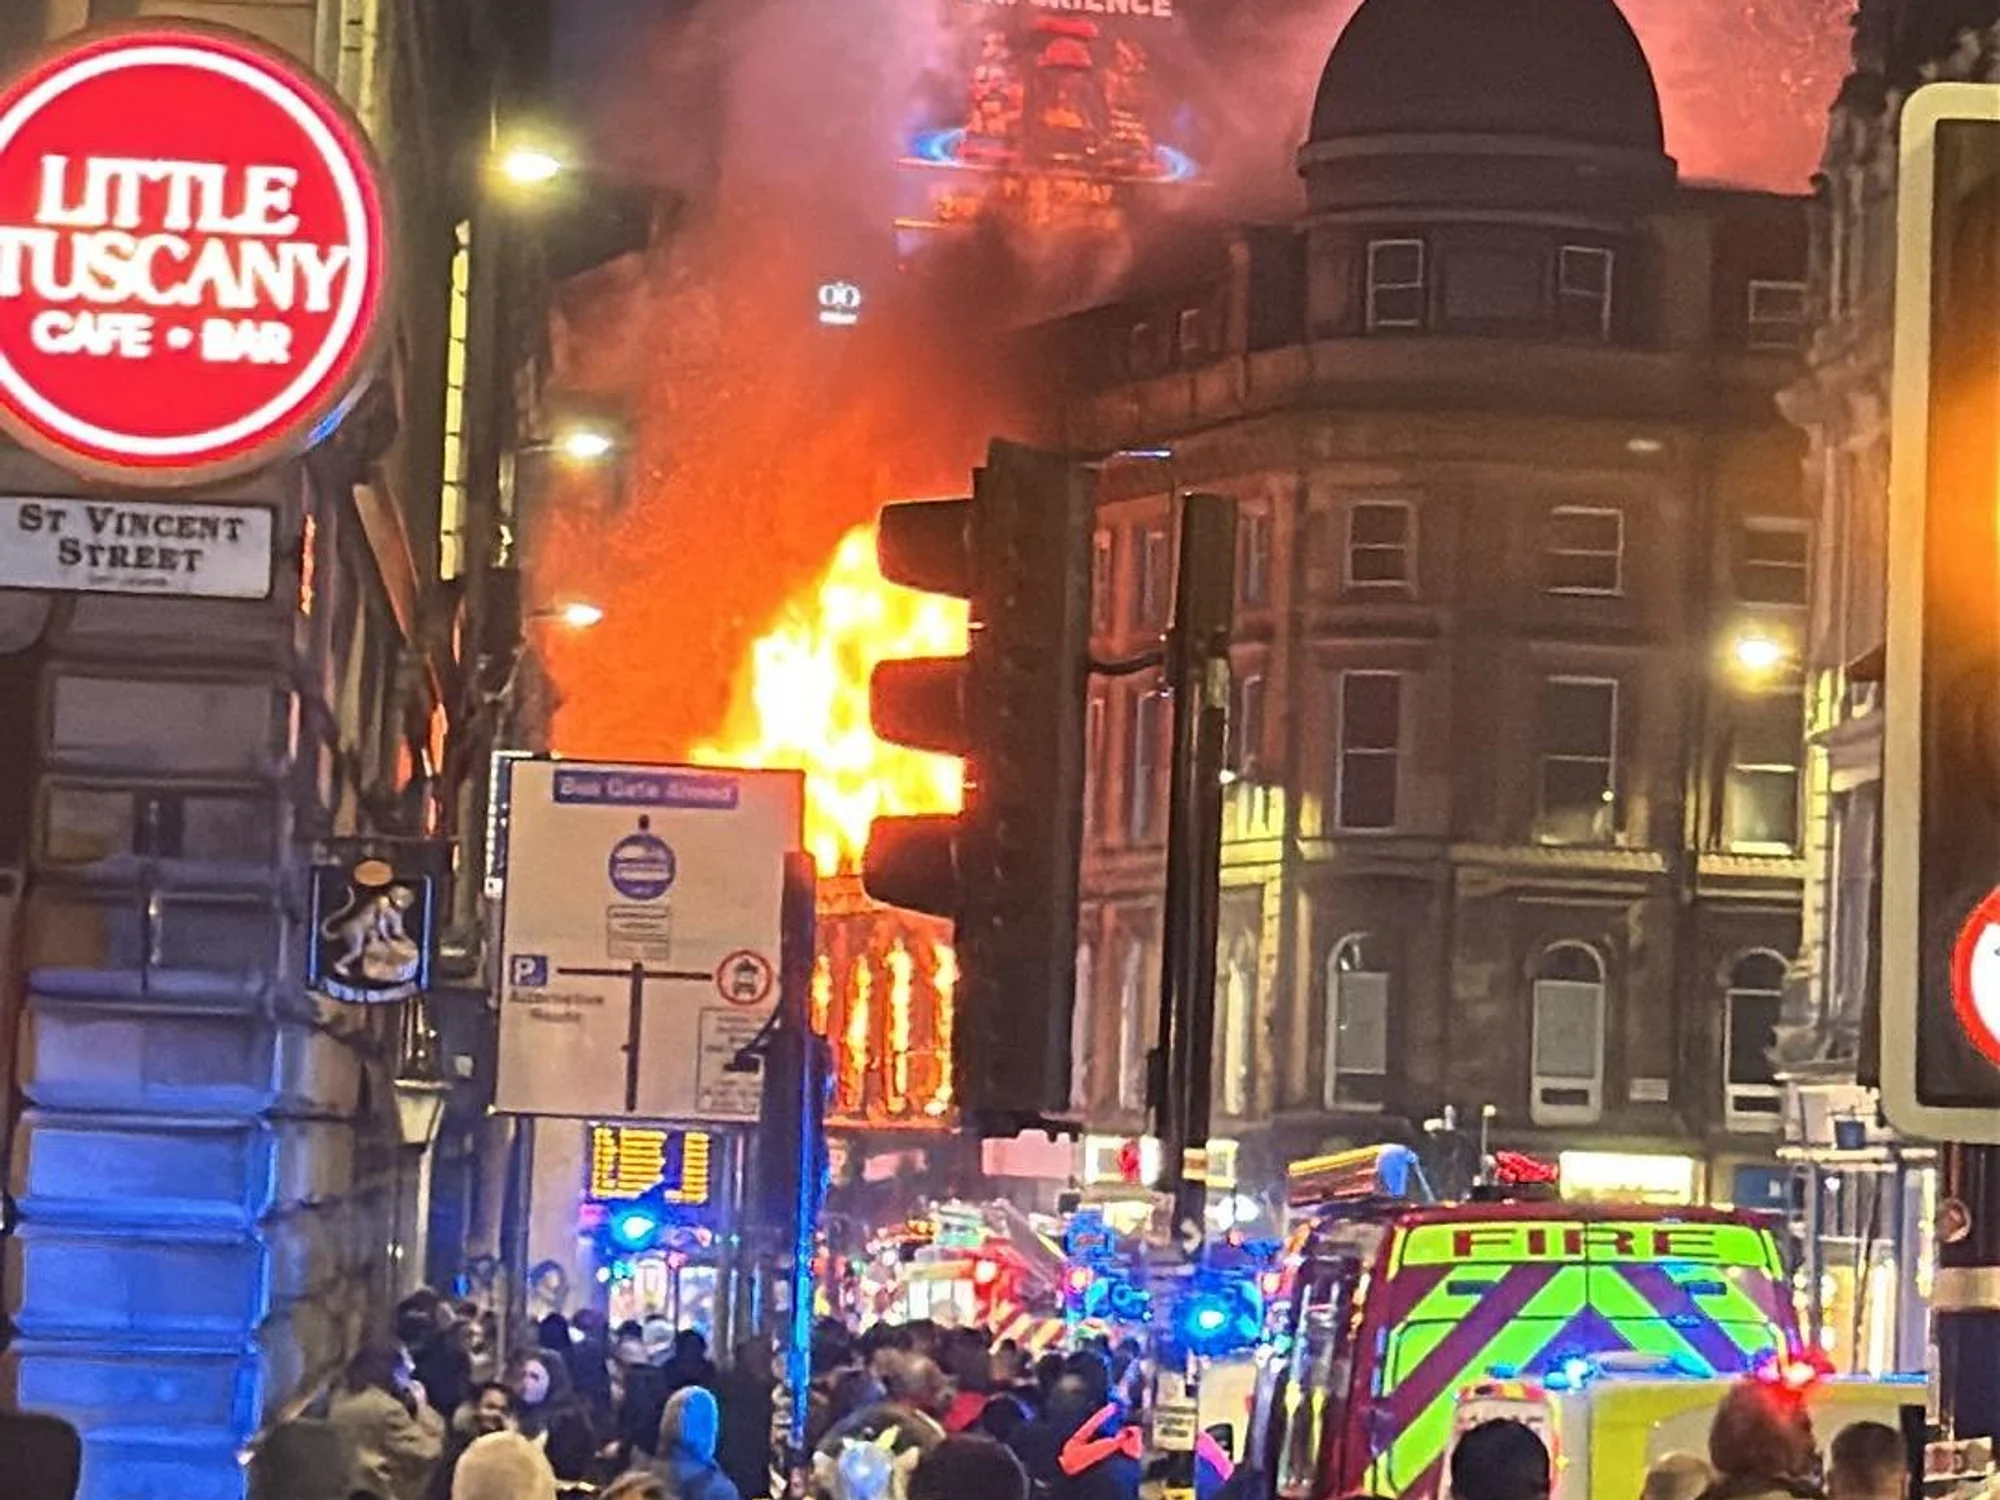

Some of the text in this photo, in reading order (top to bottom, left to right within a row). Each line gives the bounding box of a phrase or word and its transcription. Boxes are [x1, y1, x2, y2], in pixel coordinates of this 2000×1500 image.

[36, 155, 300, 235] LITTLE
[0, 226, 351, 312] TUSCANY
[30, 309, 293, 364] CAFE BAR
[1453, 1228, 1720, 1259] FIRE
